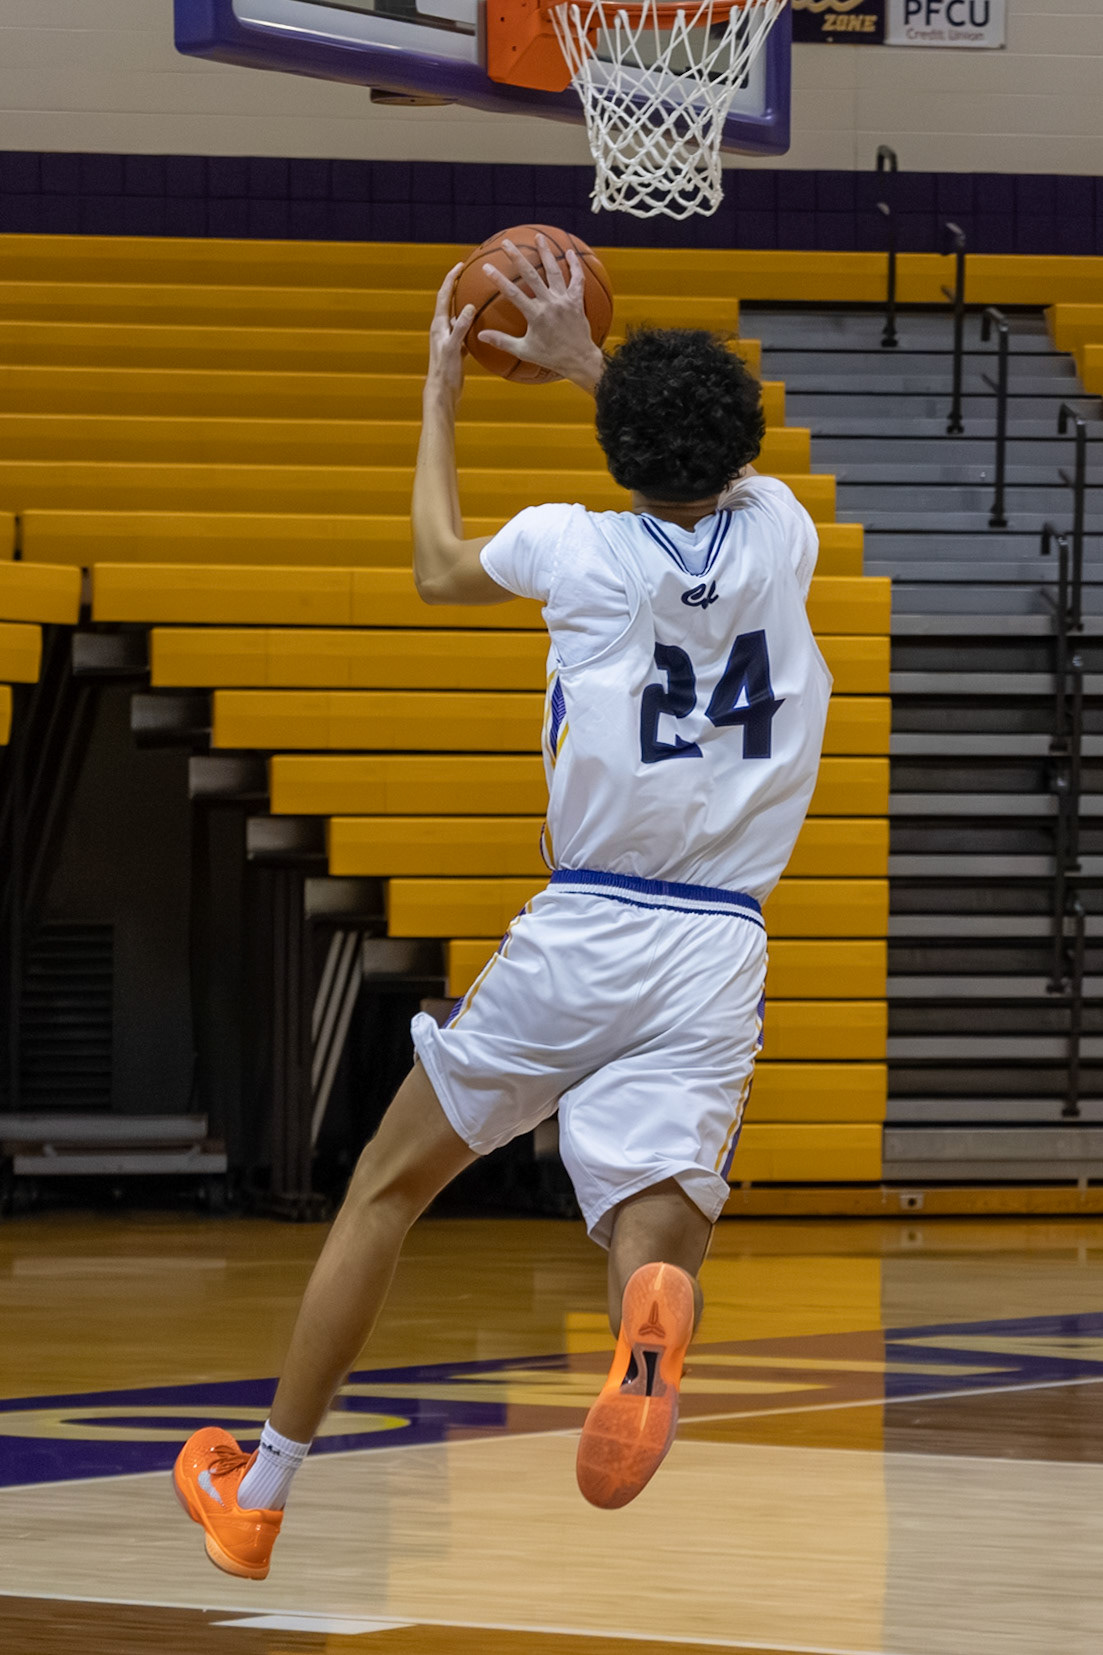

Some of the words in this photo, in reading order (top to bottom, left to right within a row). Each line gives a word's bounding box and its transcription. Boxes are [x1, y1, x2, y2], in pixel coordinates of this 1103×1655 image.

[821, 13, 878, 32] ZONE
[903, 0, 990, 27] PFCU
[905, 28, 945, 41] Credit
[640, 629, 786, 763] 24
